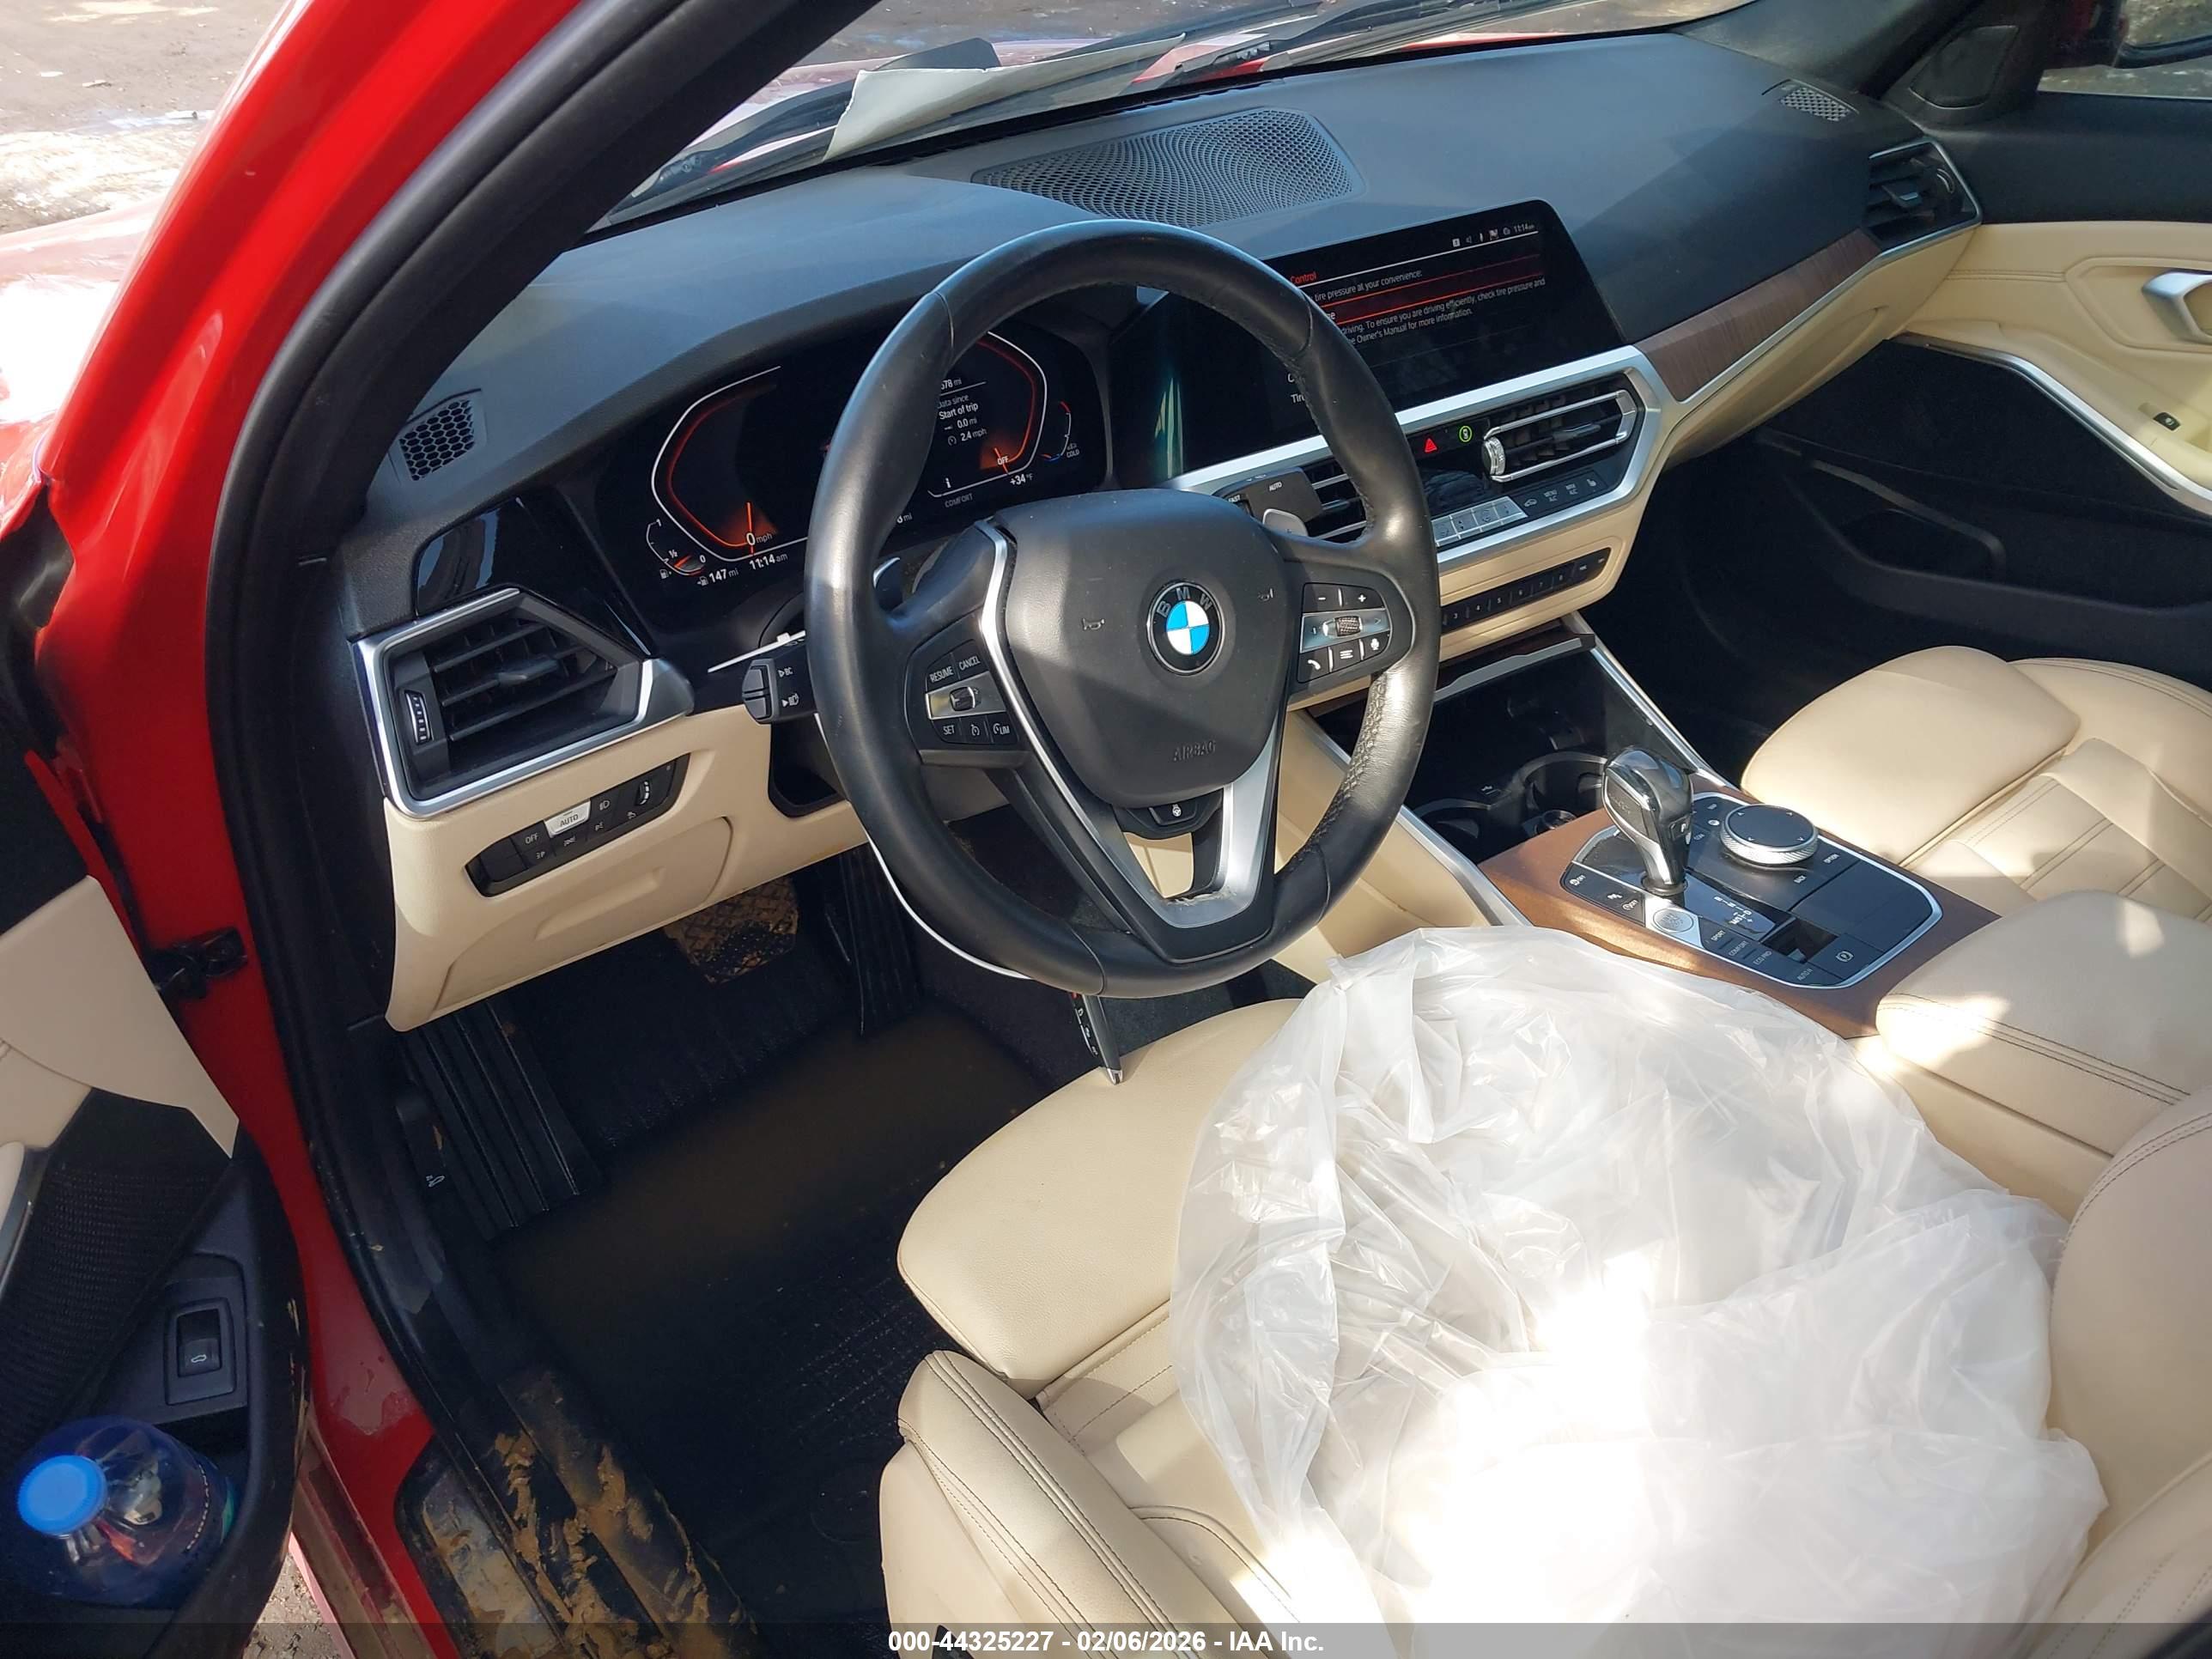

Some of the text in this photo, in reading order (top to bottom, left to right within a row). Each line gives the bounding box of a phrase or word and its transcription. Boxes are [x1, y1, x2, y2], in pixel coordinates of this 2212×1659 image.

[1290, 271, 1316, 284] Control
[1328, 285, 1357, 300] pressure
[1364, 279, 1380, 292] your
[1365, 319, 1375, 330] To
[1376, 313, 1398, 325] ensure
[1399, 313, 1412, 322] you
[1412, 307, 1423, 318] are
[1423, 301, 1445, 317] driving
[1477, 290, 1496, 301] check
[1507, 282, 1533, 296] pressure
[1534, 276, 1546, 289] and
[1382, 322, 1407, 336] Manual
[1419, 315, 1436, 327] more
[1436, 307, 1473, 323] information.
[952, 394, 969, 404] since
[939, 402, 979, 420] Start of trip
[957, 416, 977, 428] 0.0 mi
[960, 428, 988, 441] 2.4 mph
[997, 456, 1009, 465] OFF
[1066, 449, 1080, 459] COLD
[1010, 473, 1026, 485] +34
[945, 493, 973, 508] COMFORT
[745, 532, 773, 546] 0 mph
[700, 555, 706, 563] 0
[749, 554, 775, 570] 11:14
[708, 568, 739, 584] 147 mi
[1157, 586, 1214, 618] BMW
[958, 655, 981, 671] CANCEL
[930, 665, 955, 684] RESUME
[943, 725, 955, 735] SET
[1173, 739, 1217, 762] AIRBAG
[560, 813, 580, 828] AUTO
[525, 831, 539, 844] OFF
